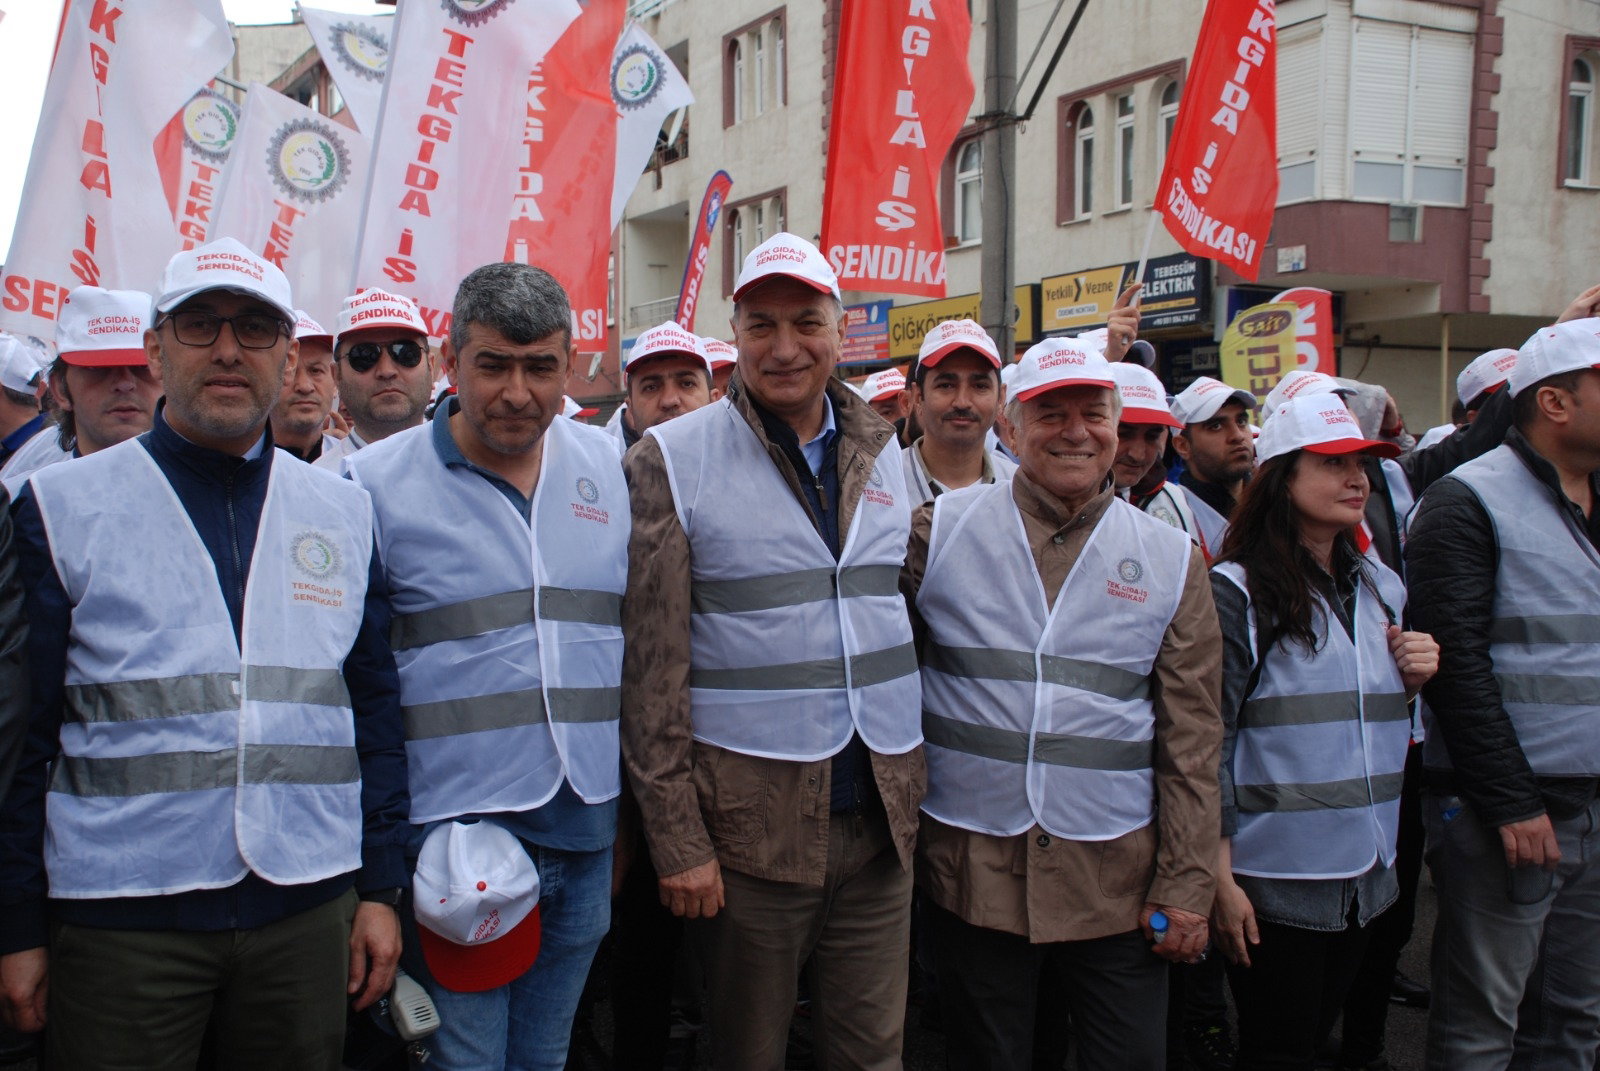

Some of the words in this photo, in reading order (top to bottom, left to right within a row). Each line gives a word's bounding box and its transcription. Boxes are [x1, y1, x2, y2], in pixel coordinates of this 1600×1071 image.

[398, 28, 475, 217] TEKGIDA
[1191, 141, 1219, 194] İŞ
[875, 165, 916, 232] İŞ
[1167, 177, 1257, 266] SENDİKASI
[382, 228, 417, 284] İŞ
[756, 249, 771, 260] TEK
[756, 253, 804, 267] SENDİKASI
[196, 253, 265, 274] TEKGIDA-İŞ
[1154, 260, 1196, 278] TEBESSÜM
[196, 263, 263, 282] SENDİKASI
[1045, 283, 1073, 301] Yetkili
[1086, 280, 1113, 295] Vezne
[87, 317, 101, 327] TEK
[104, 315, 140, 326] GIDA-İŞ
[350, 306, 413, 324] SENDİKASI
[88, 325, 139, 335] SENDİKASI
[892, 306, 977, 347] ÇİĞKÖİ
[647, 330, 662, 341] TEK
[645, 339, 696, 353] SENDİKASI
[1037, 353, 1053, 364] TEK
[1055, 348, 1087, 360] GIDA-İŞ
[1039, 357, 1085, 371] SENDİKASI
[1106, 579, 1120, 590] TEK
[293, 593, 342, 607] SENDİKASI
[1107, 587, 1146, 604] SENDİKASI
